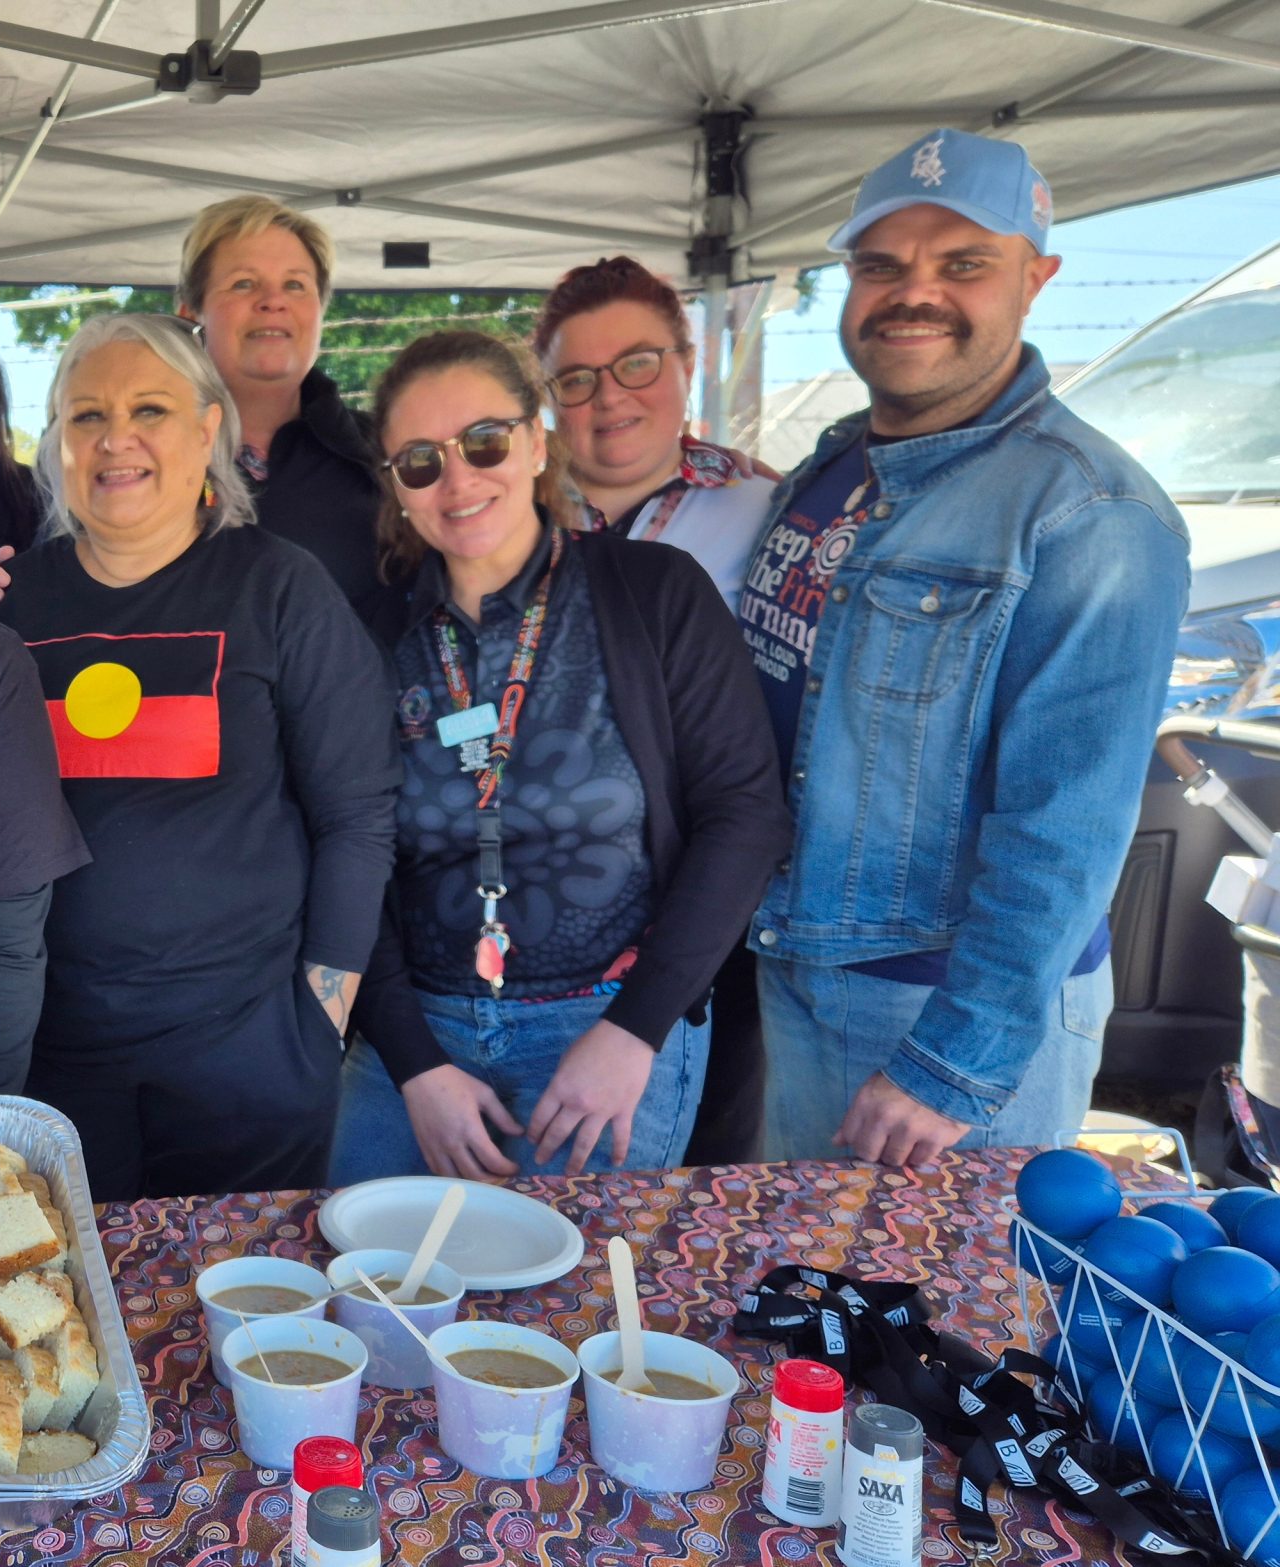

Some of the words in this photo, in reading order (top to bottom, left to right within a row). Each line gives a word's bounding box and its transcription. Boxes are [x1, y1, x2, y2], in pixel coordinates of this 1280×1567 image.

[766, 524, 810, 571] eep
[747, 551, 783, 596] the
[777, 567, 825, 618] Fir
[740, 591, 818, 666] urning
[753, 652, 789, 681] PROUD
[769, 641, 797, 668] LOUD
[858, 1476, 904, 1505] SAXA
